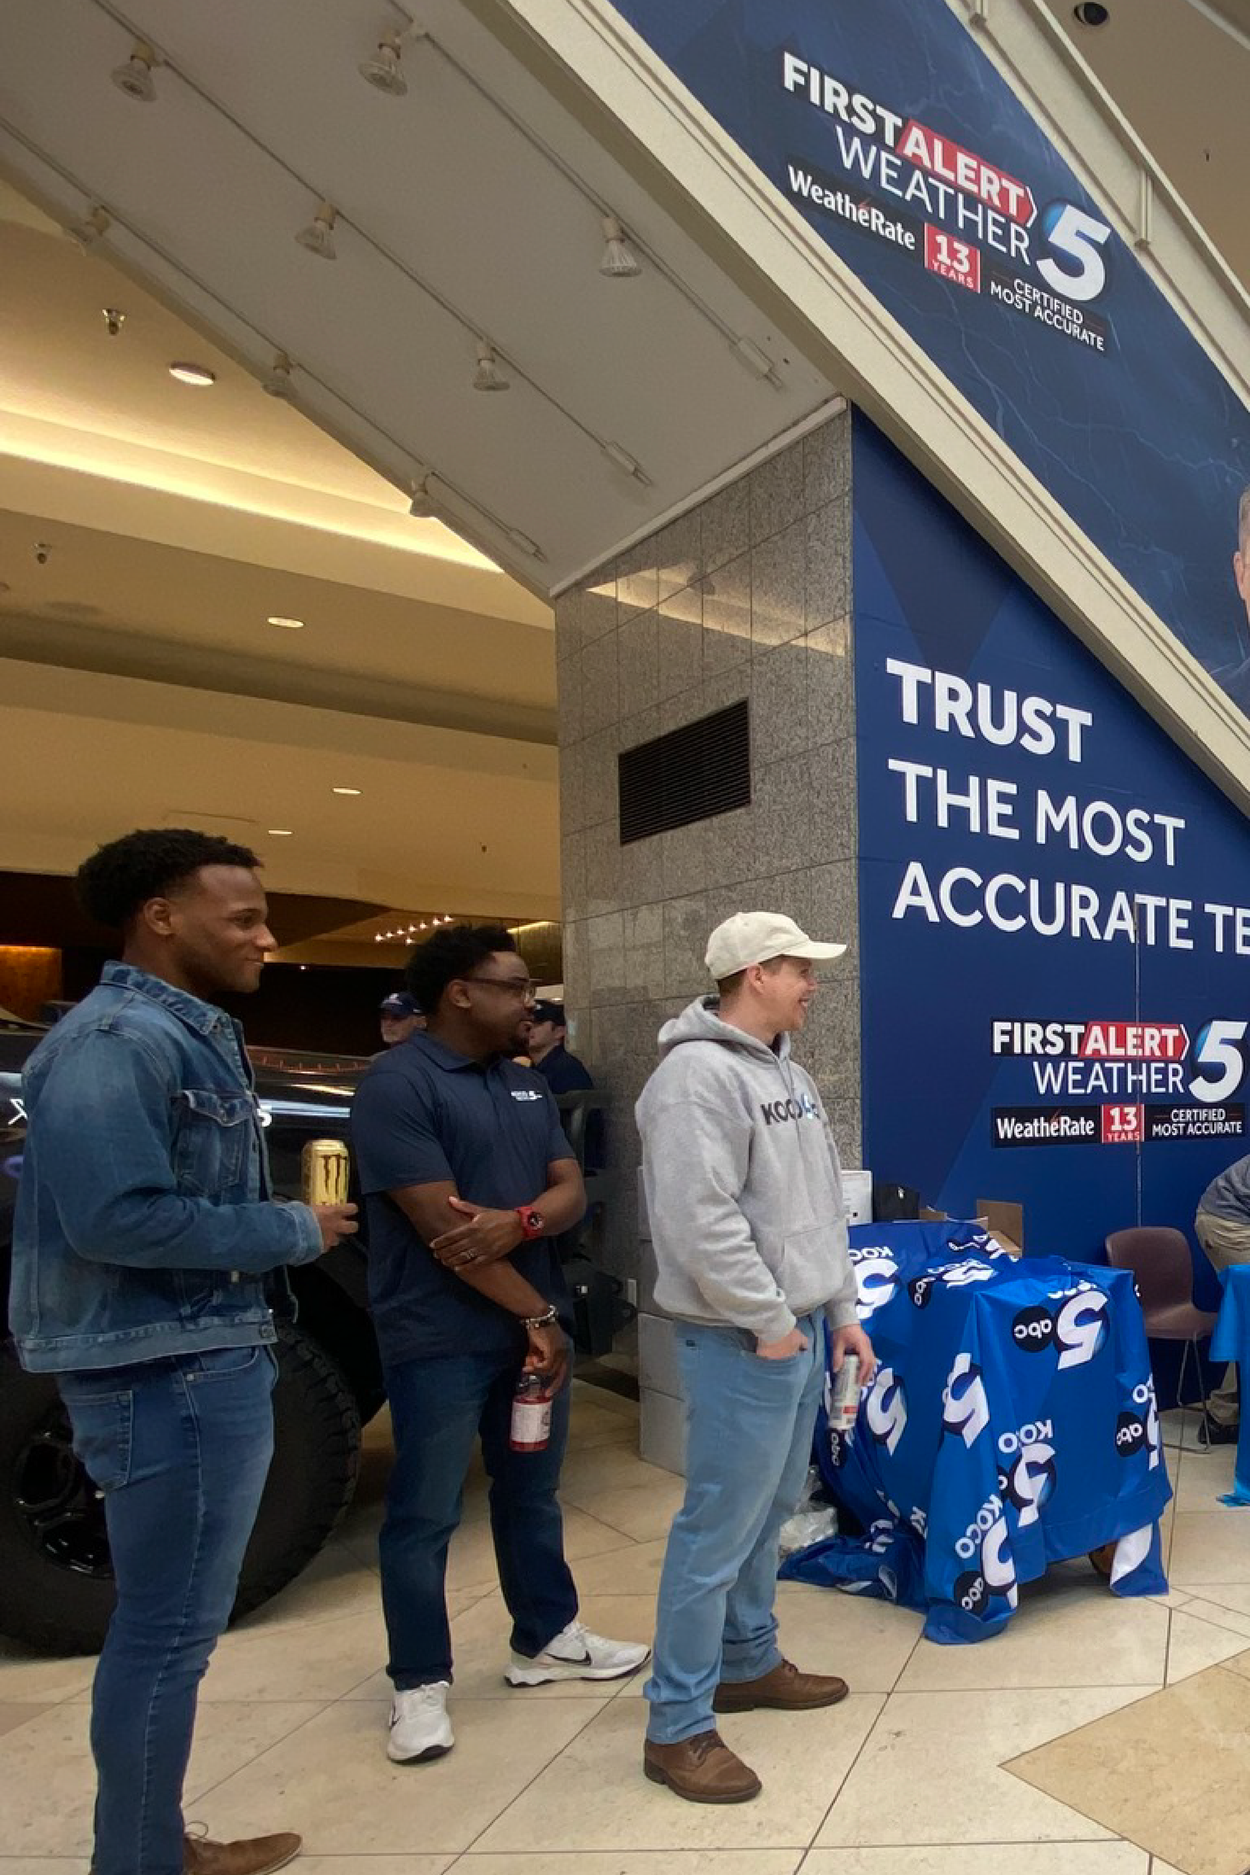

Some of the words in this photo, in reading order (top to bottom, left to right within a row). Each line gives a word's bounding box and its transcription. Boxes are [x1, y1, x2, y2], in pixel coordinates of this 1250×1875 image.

[783, 51, 902, 148] FIRST
[903, 125, 1024, 217] ALERT
[787, 164, 916, 250] WeatheRate
[835, 124, 1032, 266] WEATHER
[932, 260, 974, 289] YEARS
[935, 235, 970, 273] 13
[1036, 204, 1111, 301] 5
[990, 281, 1031, 314] MOST
[1033, 305, 1104, 352] ACCURATE
[1013, 278, 1083, 324] CERTIFIED
[886, 657, 1093, 763] TRUST
[887, 758, 1020, 840] THE
[1036, 789, 1185, 866] MOST
[891, 861, 1195, 950] ACCURATE
[992, 1021, 1085, 1055] FIRST
[1085, 1025, 1180, 1057] ALERT
[1188, 1020, 1249, 1103] 5
[1032, 1061, 1185, 1095] WEATHER
[995, 1114, 1095, 1140] WeatheRate
[1106, 1131, 1140, 1142] YEARS
[1109, 1107, 1137, 1130] 13
[1152, 1123, 1185, 1137] MOST
[1186, 1121, 1243, 1135] ACCURATE
[1170, 1109, 1226, 1123] CERTIFIED
[1014, 1319, 1052, 1340] abc
[1057, 1290, 1109, 1371] 5
[943, 1352, 990, 1450] 5
[998, 1420, 1054, 1455] KOO
[954, 1494, 1004, 1560] KOCO
